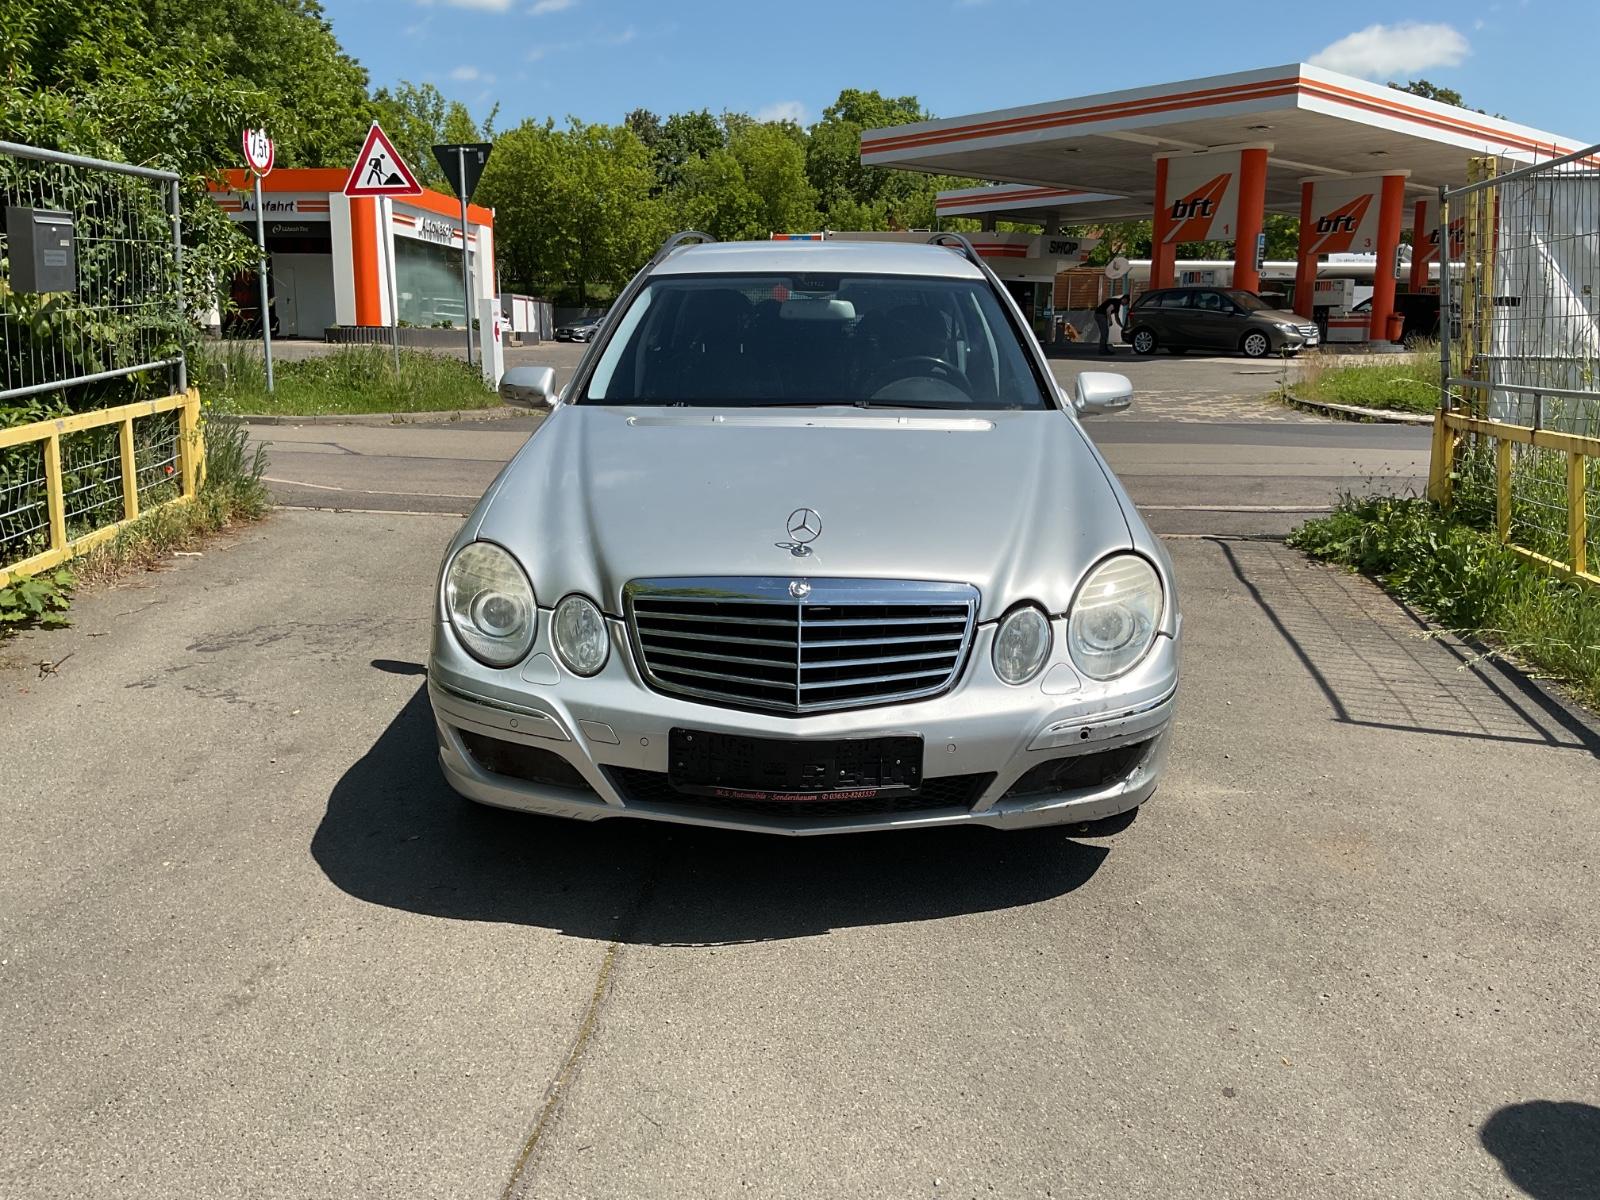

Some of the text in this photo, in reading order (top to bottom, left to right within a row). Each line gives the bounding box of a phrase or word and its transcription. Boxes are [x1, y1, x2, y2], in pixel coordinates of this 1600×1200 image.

[1170, 199, 1214, 220] bft
[1223, 224, 1229, 234] 1
[1316, 215, 1356, 234] bft
[1049, 240, 1079, 256] SHOP
[1364, 238, 1372, 248] 3
